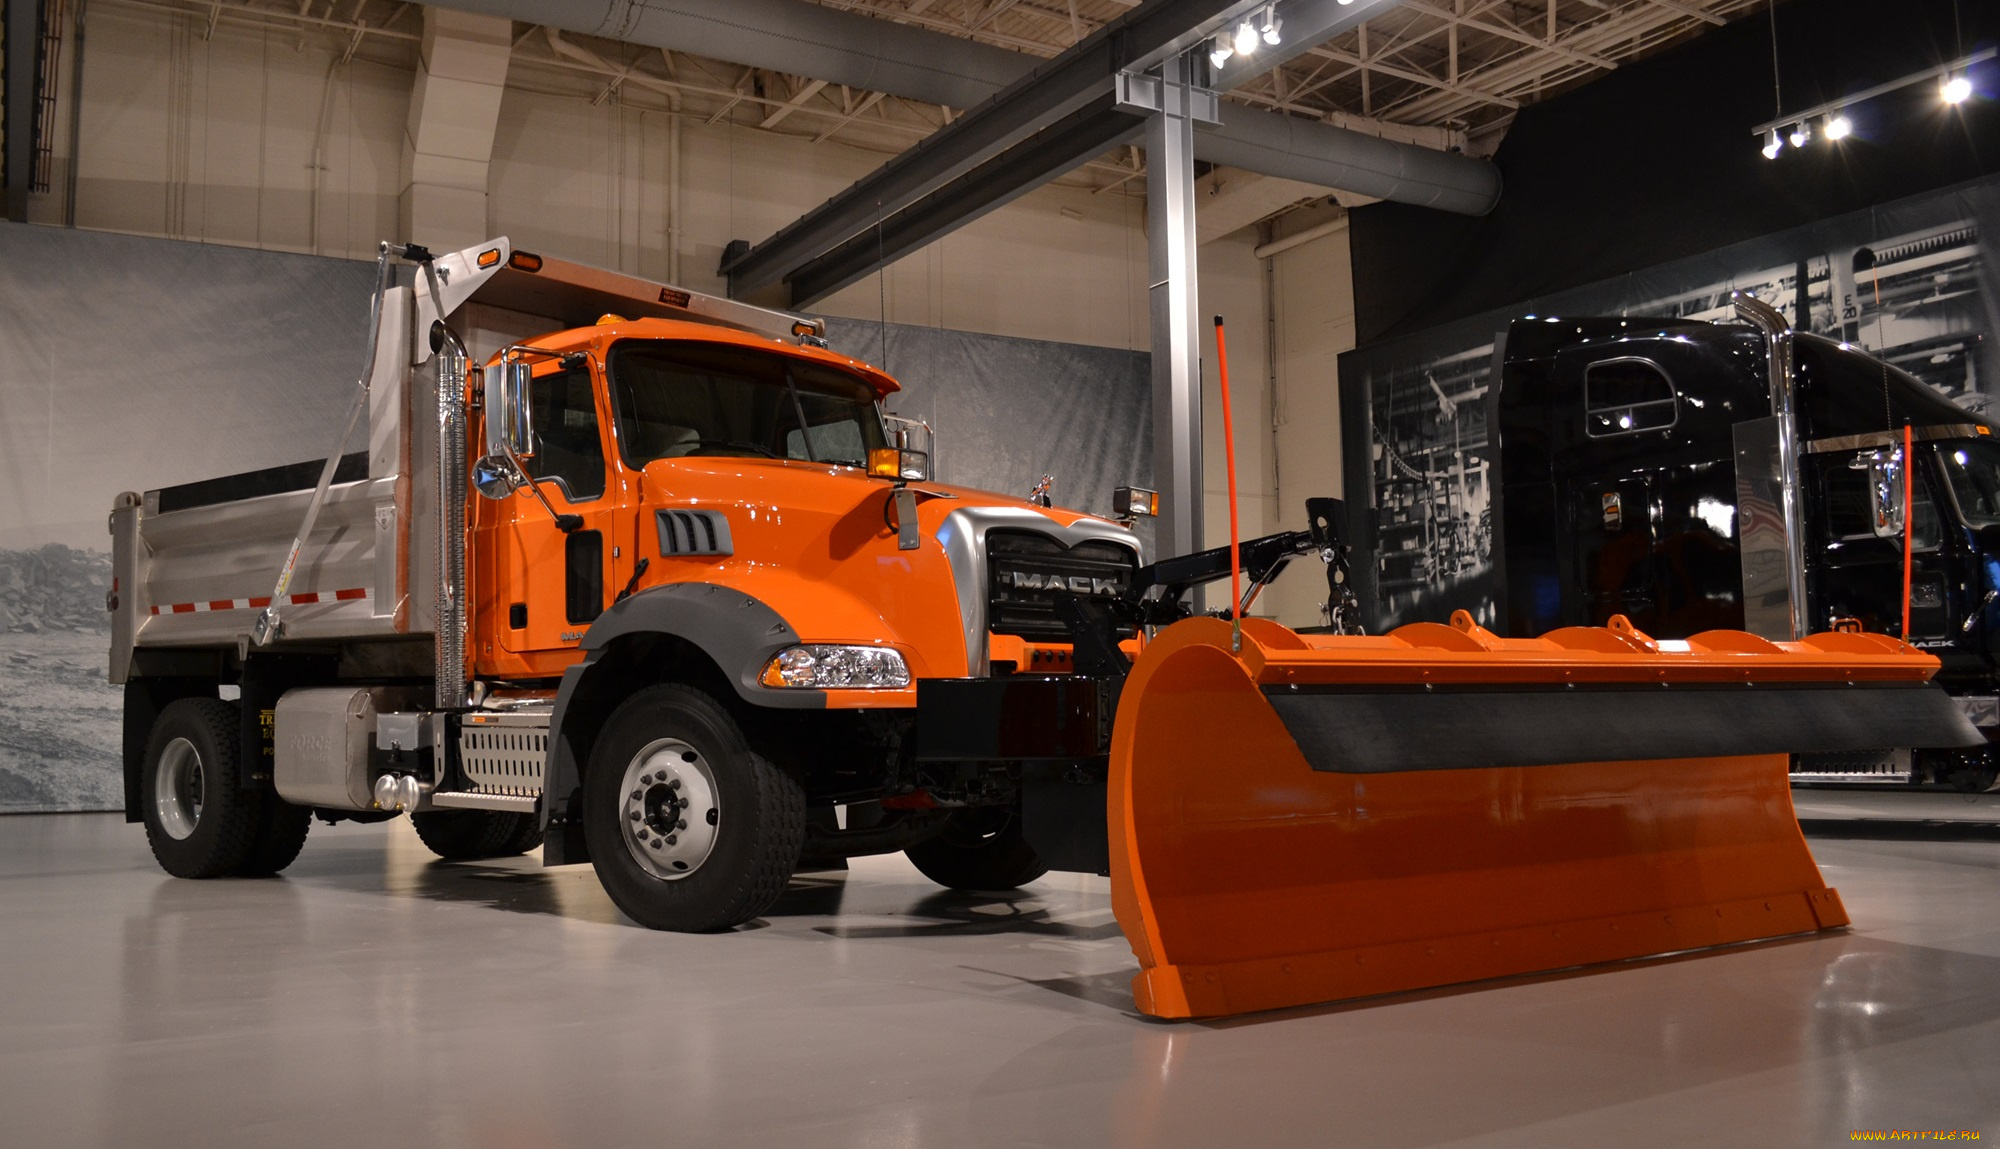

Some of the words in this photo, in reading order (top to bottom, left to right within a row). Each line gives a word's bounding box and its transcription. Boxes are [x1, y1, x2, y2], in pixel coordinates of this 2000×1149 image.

[1844, 294, 1852, 306] E
[1842, 306, 1857, 320] 20
[1013, 571, 1117, 596] MACK
[561, 631, 584, 640] MA
